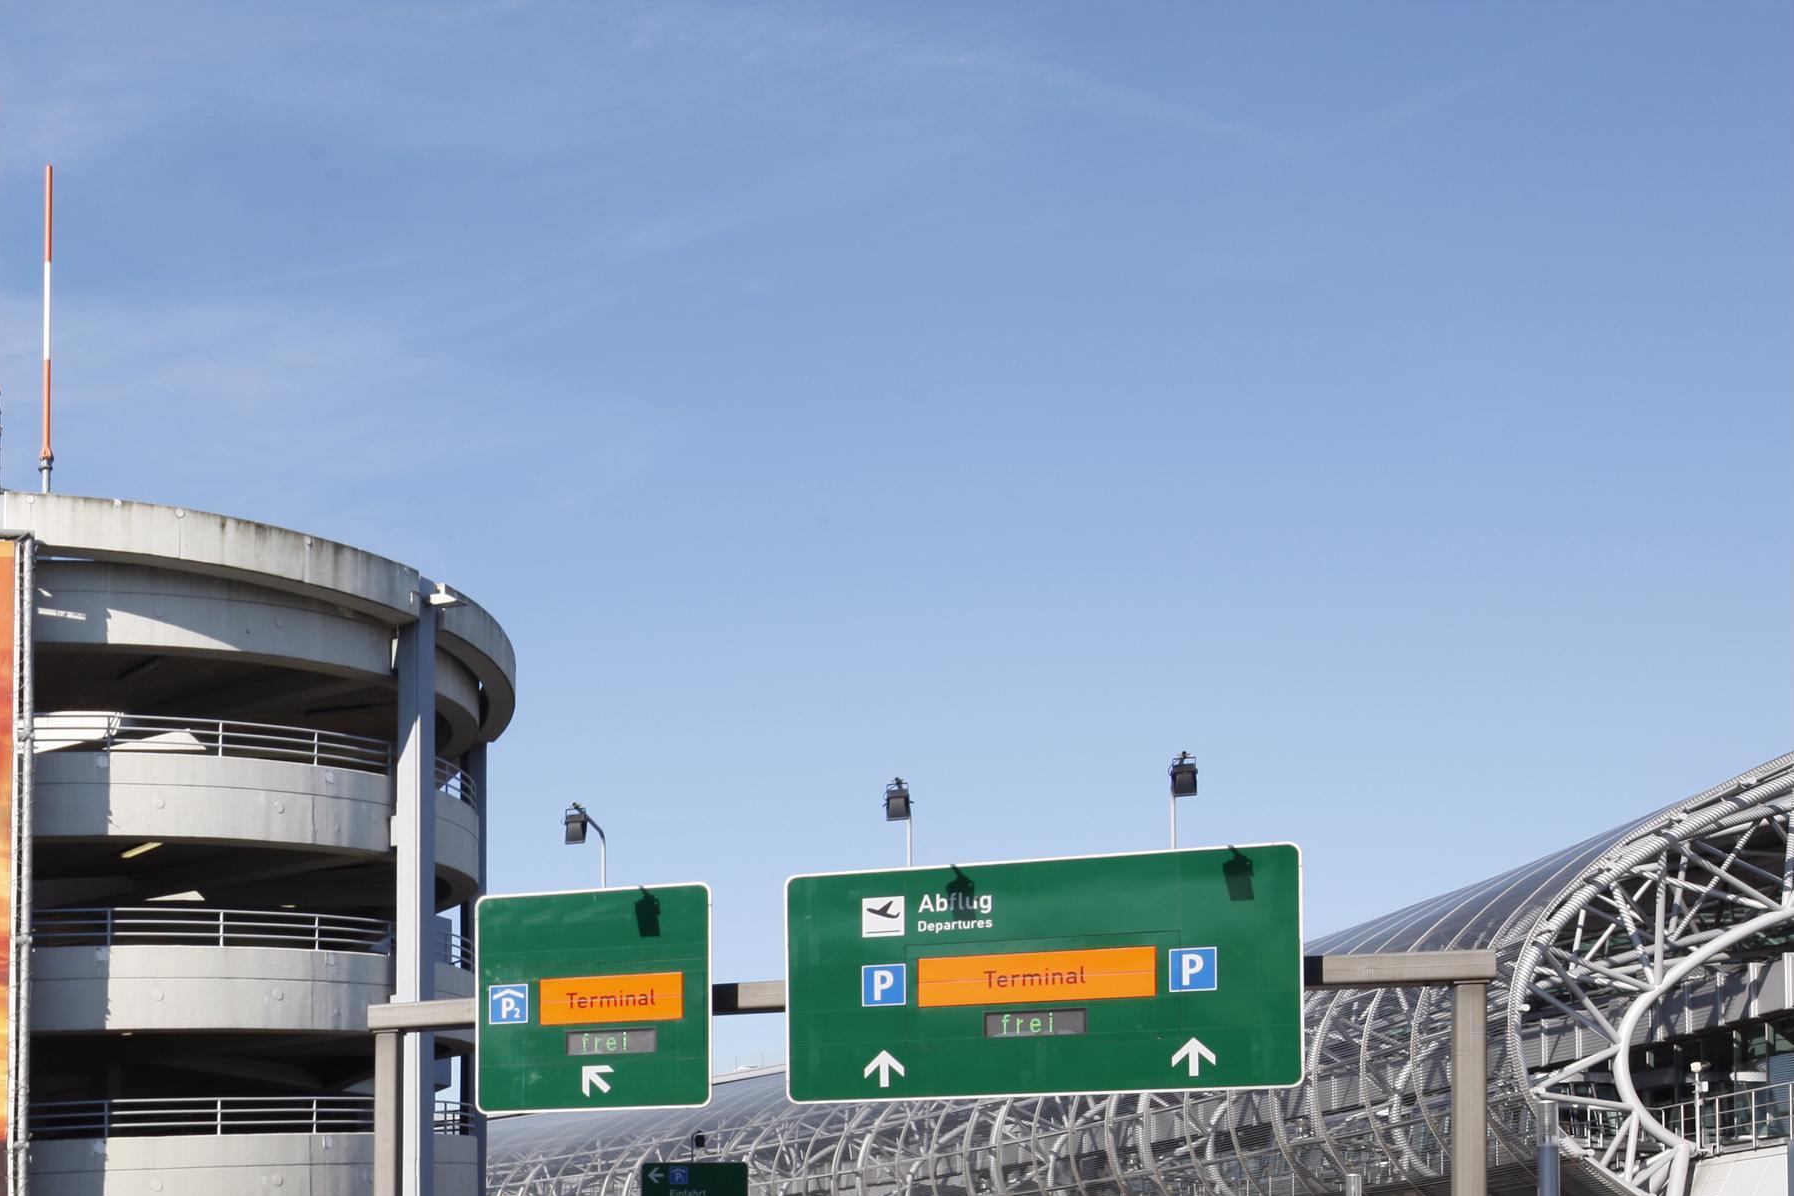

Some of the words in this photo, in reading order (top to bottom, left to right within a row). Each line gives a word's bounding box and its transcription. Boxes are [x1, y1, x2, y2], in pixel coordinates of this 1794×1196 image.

[918, 893, 992, 915] Abflug
[918, 917, 993, 934] Departures
[984, 966, 1086, 990] Terminal
[1182, 954, 1204, 986] P
[874, 970, 894, 1002] P
[566, 989, 656, 1010] Terminal
[1001, 1012, 1055, 1034] frei
[581, 1032, 629, 1052] frei
